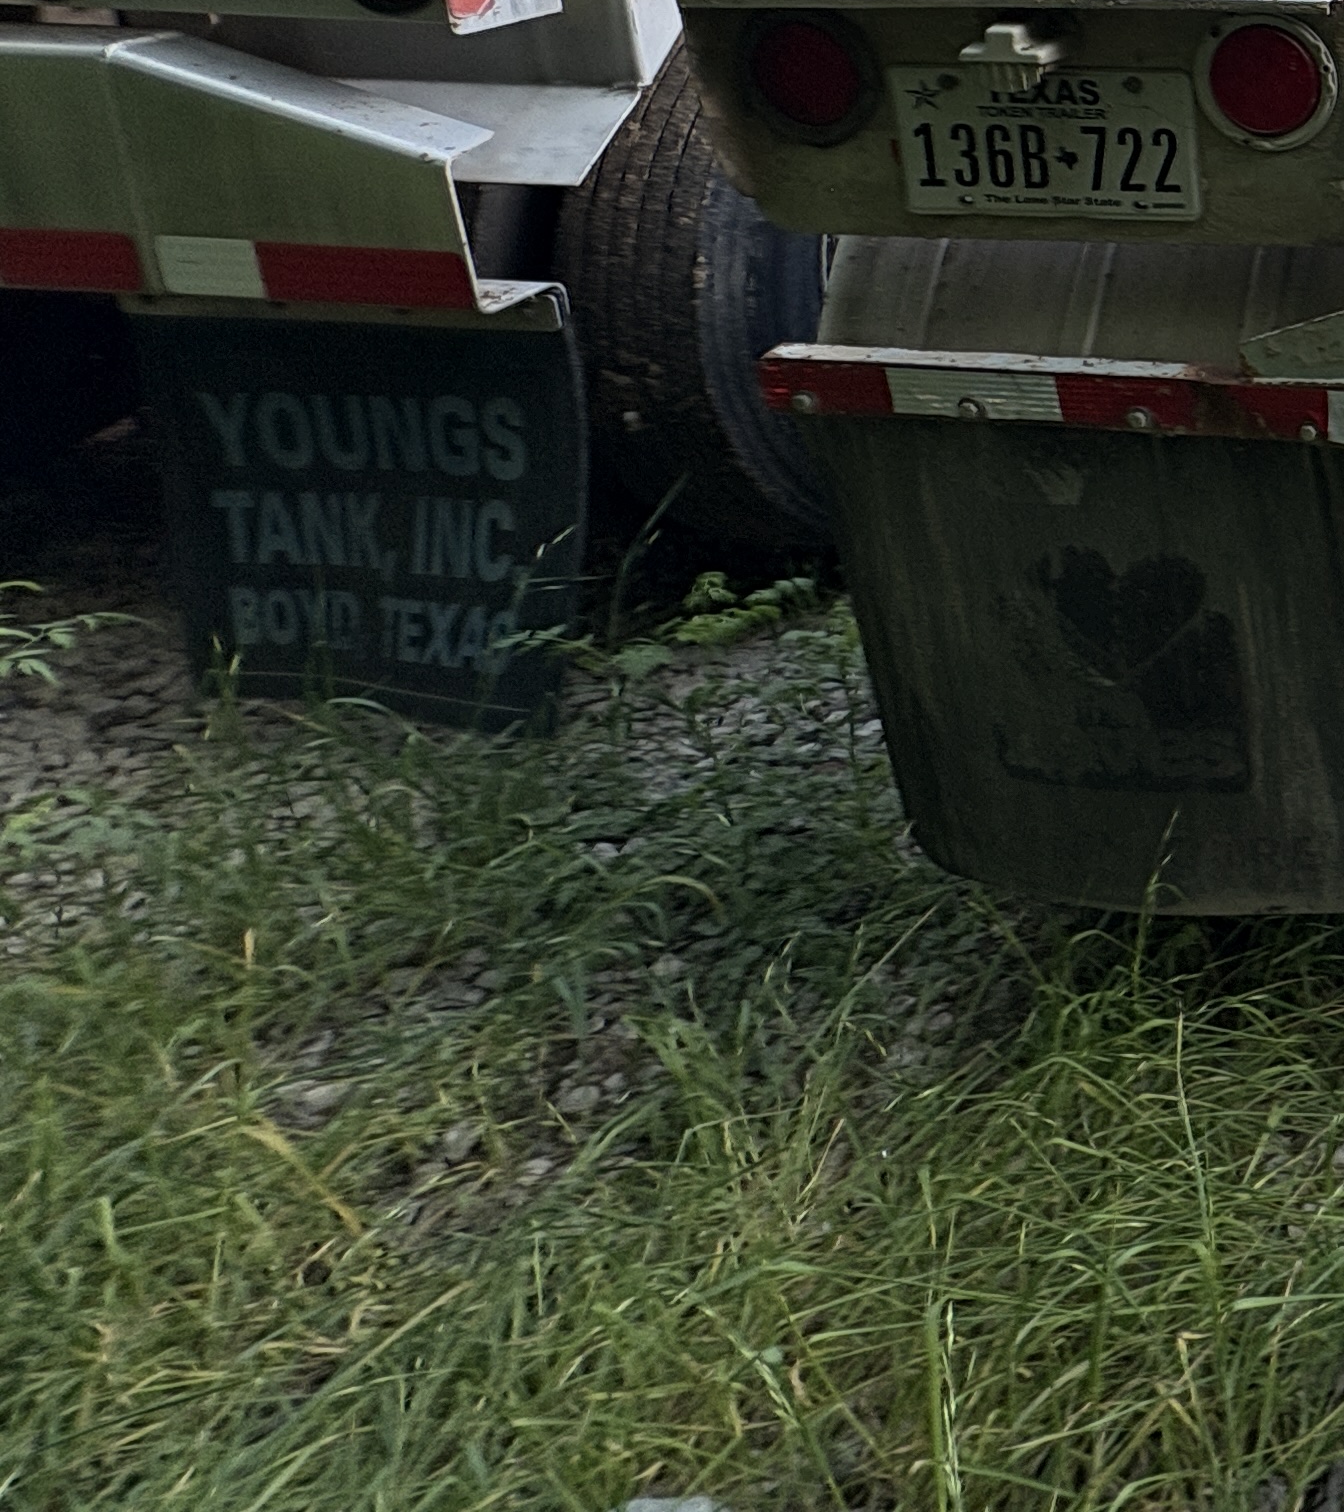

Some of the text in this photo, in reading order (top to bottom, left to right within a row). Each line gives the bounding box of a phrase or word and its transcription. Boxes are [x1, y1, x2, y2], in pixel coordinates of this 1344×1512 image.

[914, 123, 1182, 193] 136B 722
[196, 390, 527, 481] YOUNGS
